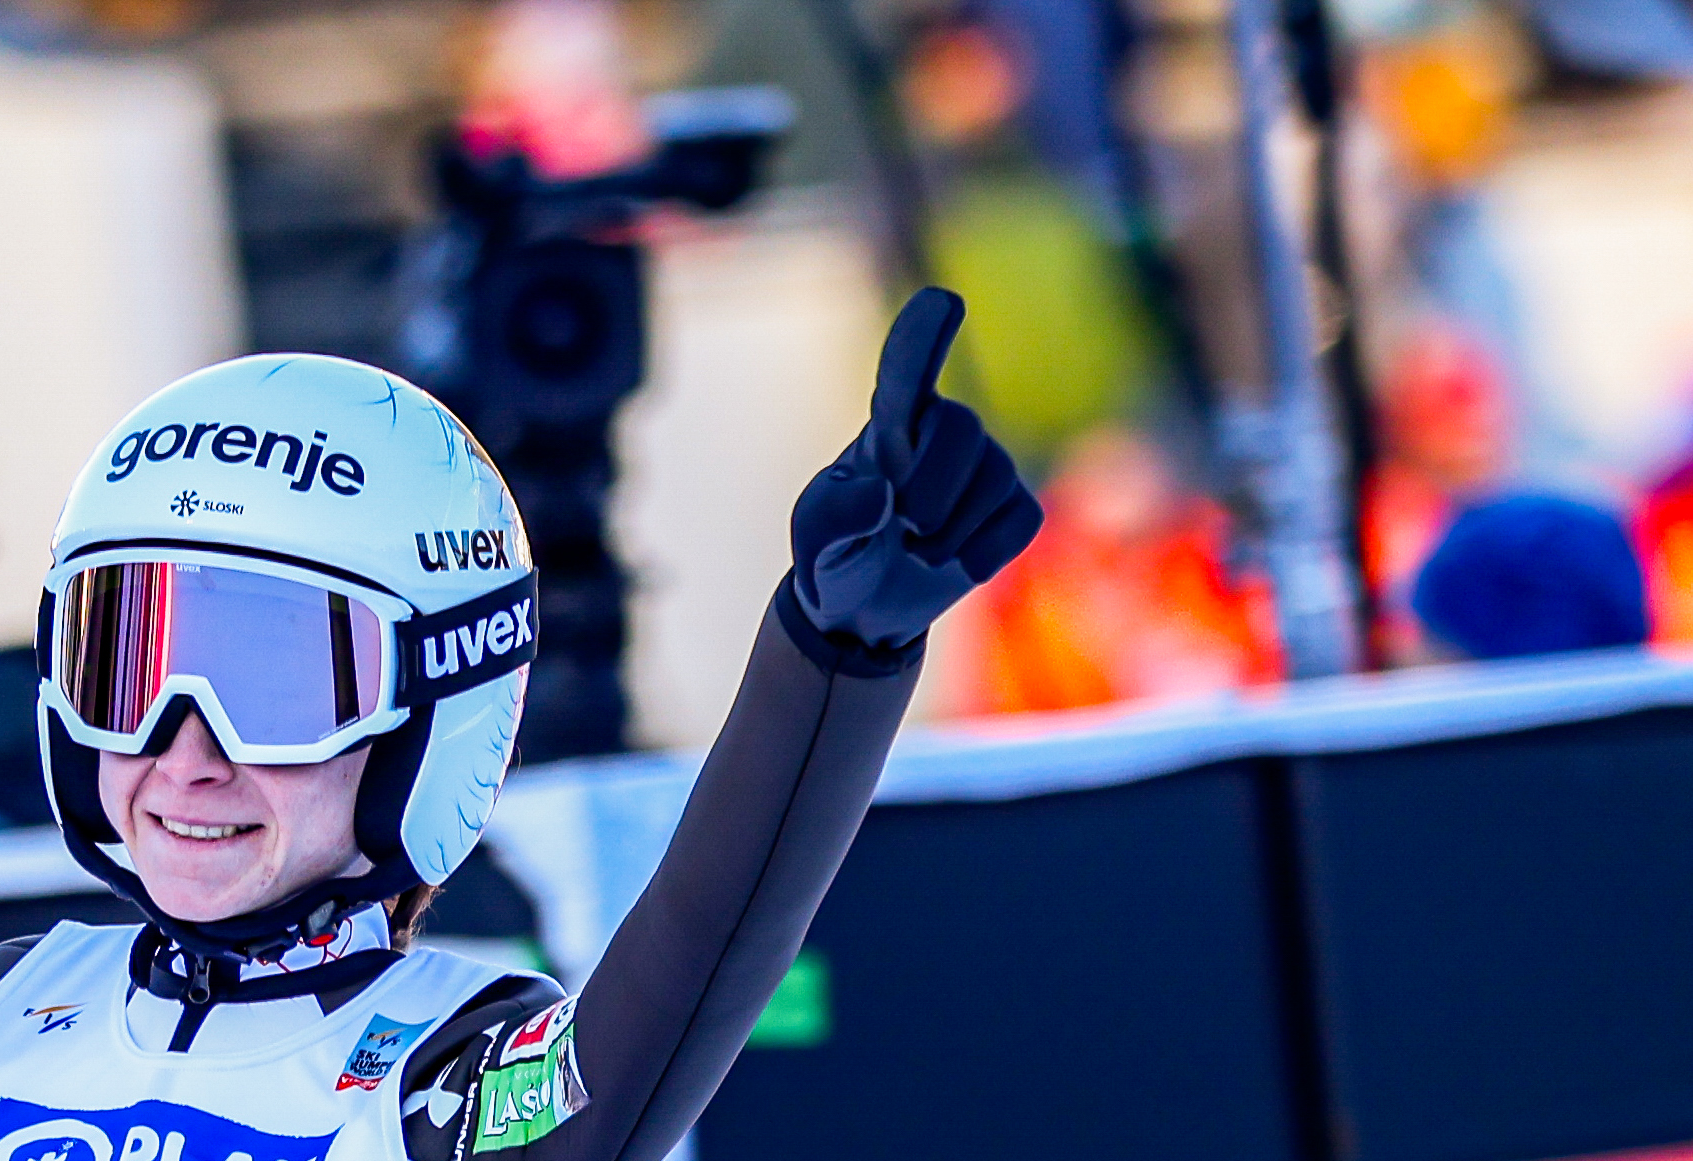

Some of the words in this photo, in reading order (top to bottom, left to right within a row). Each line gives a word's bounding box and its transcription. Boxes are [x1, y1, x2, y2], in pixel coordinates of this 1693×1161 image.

[106, 422, 366, 497] gorenje
[202, 500, 245, 516] SLOSKI
[414, 527, 510, 572] uvex
[423, 598, 531, 680] uvex
